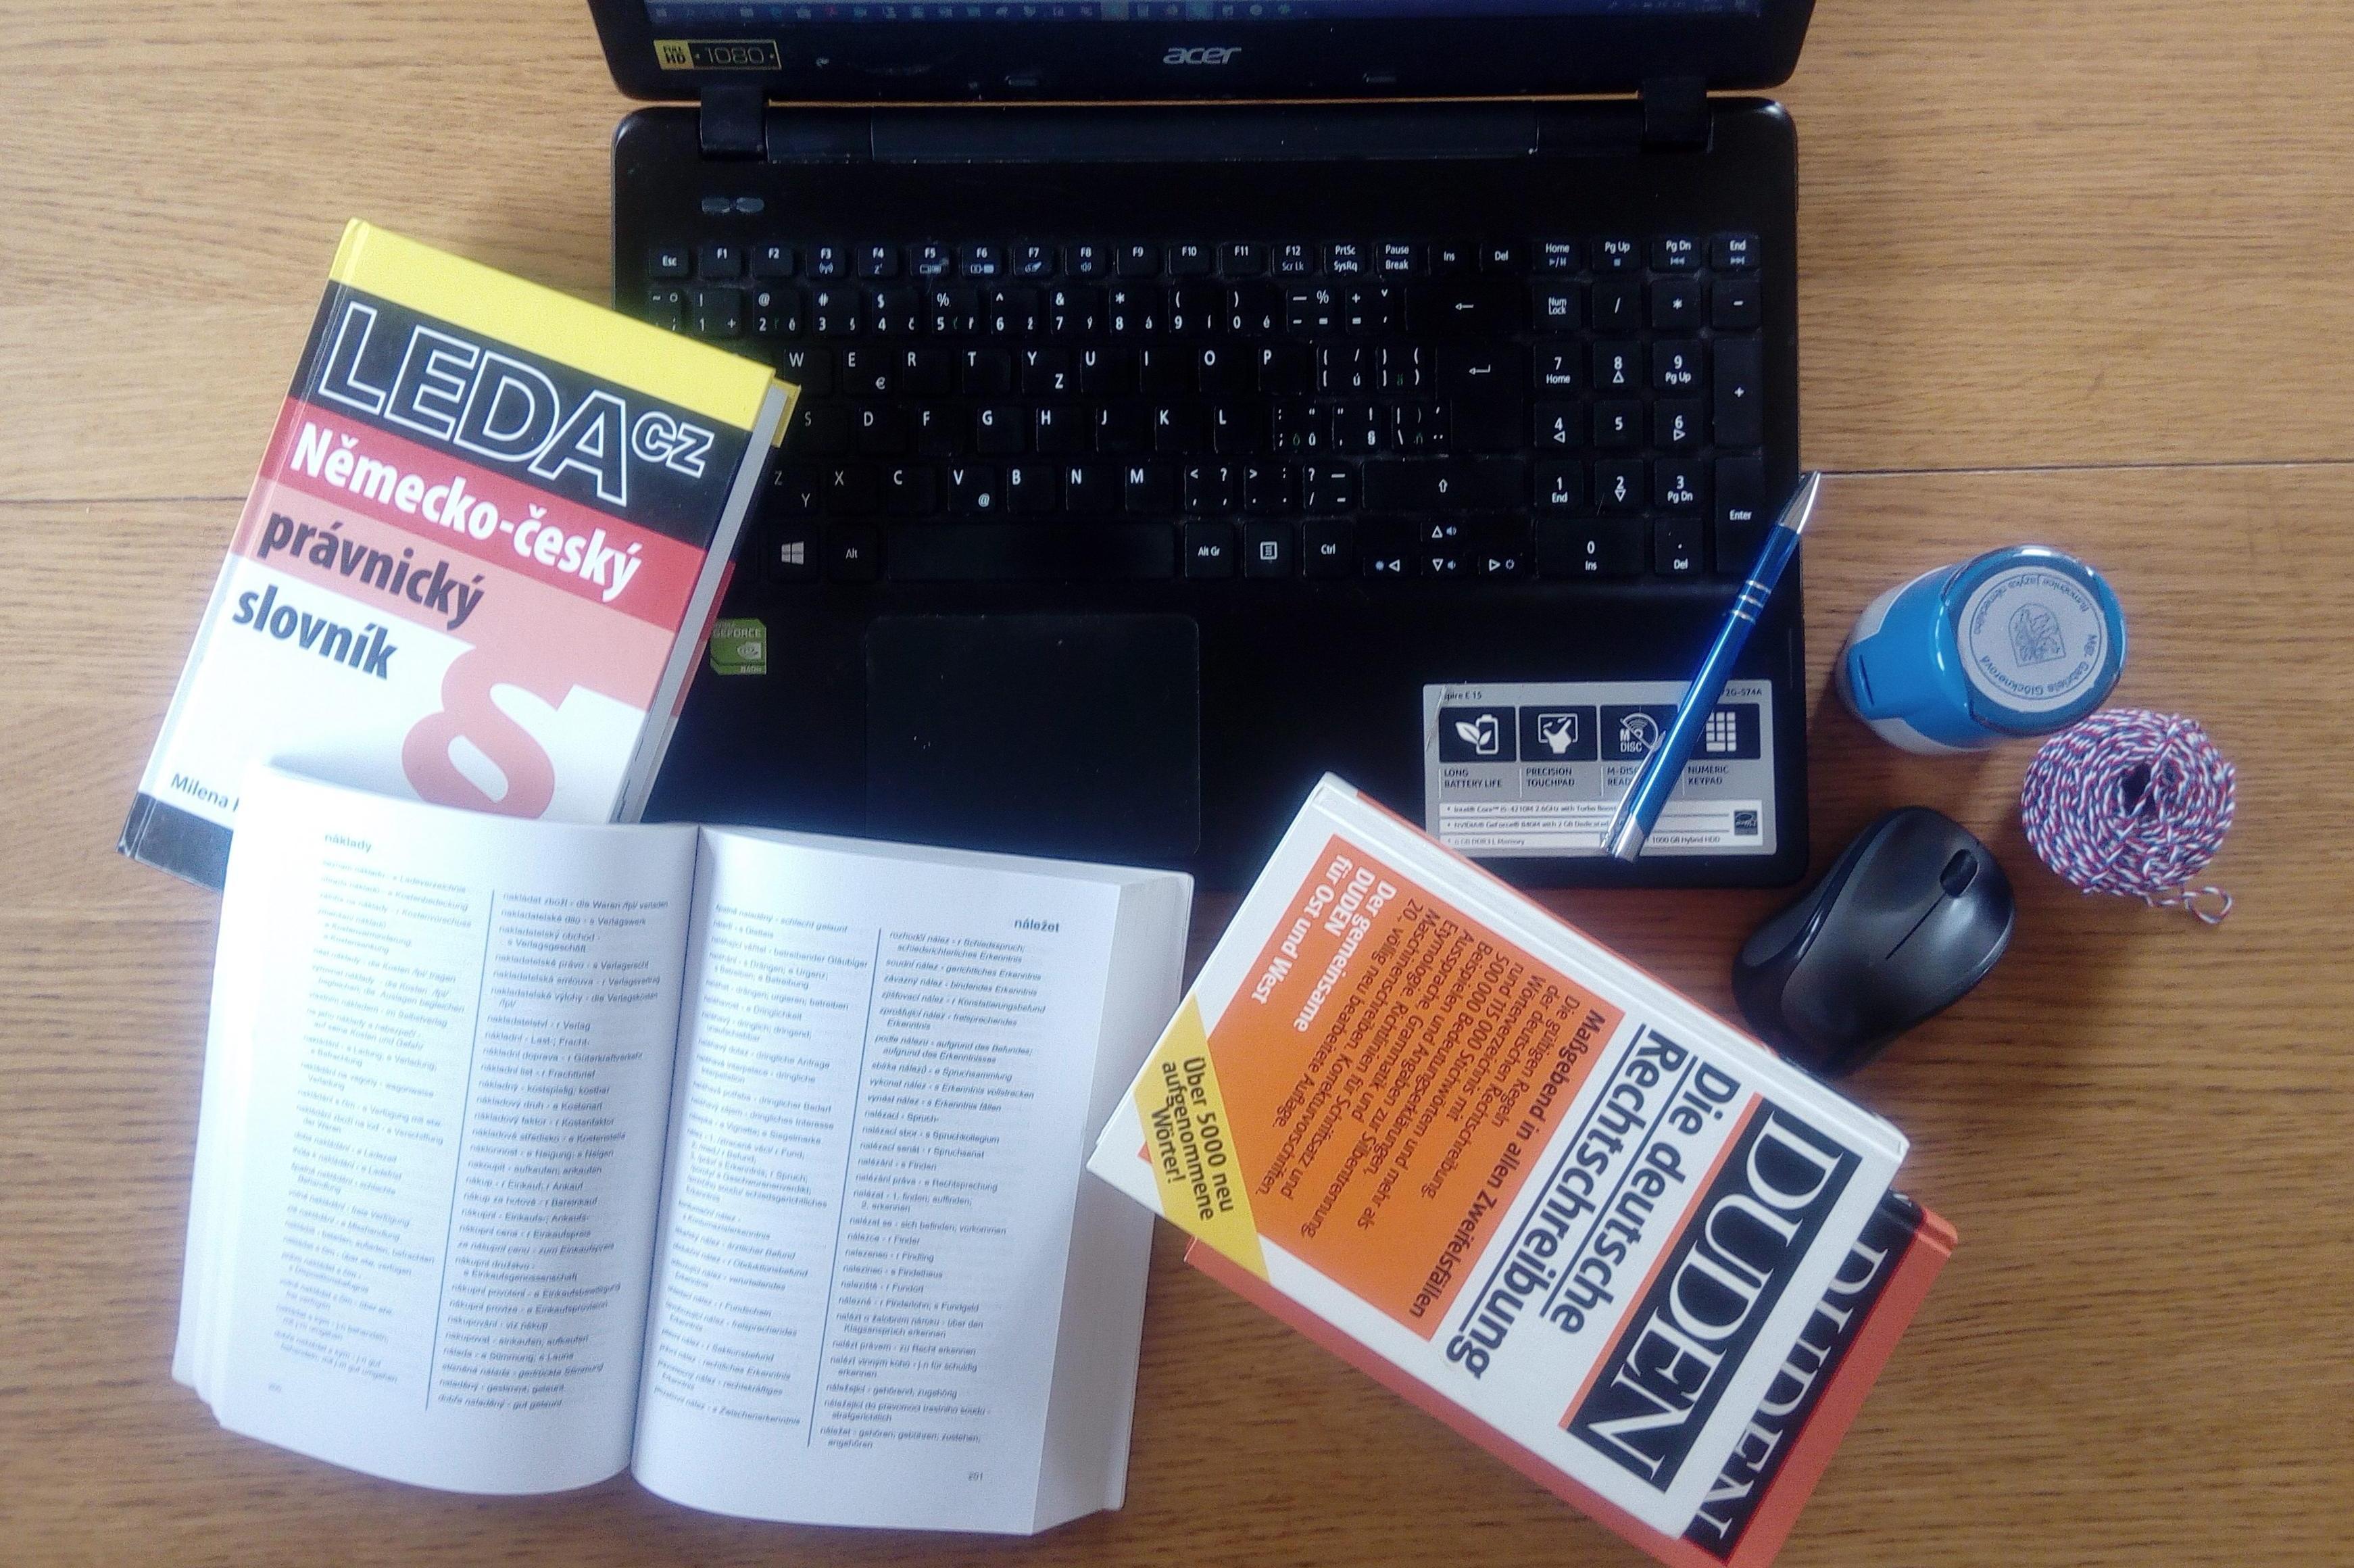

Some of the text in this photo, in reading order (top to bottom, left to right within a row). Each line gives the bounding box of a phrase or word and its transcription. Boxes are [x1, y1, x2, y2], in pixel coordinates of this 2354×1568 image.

[705, 47, 764, 64] 1080
[1162, 47, 1242, 65] acer
[1029, 247, 1039, 258] F7
[1081, 247, 1092, 257] F8
[1133, 247, 1143, 257] F9
[1182, 247, 1196, 256] F10
[1235, 246, 1248, 255] F11
[1286, 246, 1300, 255] F12
[1335, 245, 1355, 255] PrtSc
[1386, 245, 1408, 254] Pause
[1546, 243, 1569, 253] Home
[1605, 241, 1630, 253] Pg Up
[1667, 240, 1691, 252] Pg Dn
[1730, 240, 1746, 251] End
[717, 249, 727, 258] F1
[769, 248, 779, 258] F2
[821, 248, 831, 259] F3
[873, 248, 883, 258] F4
[925, 248, 935, 258] F5
[977, 248, 987, 258] F6
[1444, 251, 1454, 261] Ins
[1495, 251, 1508, 260] Del
[663, 255, 677, 266] Esc
[1334, 261, 1357, 272] SysRq
[1386, 260, 1408, 269] Break
[1549, 297, 1567, 306] Num
[1549, 306, 1565, 314] Lock
[789, 353, 804, 367] W
[849, 352, 855, 366] E
[908, 352, 916, 366] R
[968, 351, 976, 366] T
[1028, 351, 1037, 365] Y
[1086, 351, 1095, 366] U
[1204, 350, 1215, 365] O
[1264, 350, 1271, 364] P
[1554, 357, 1561, 370] 7
[1674, 356, 1682, 369] 9
[1546, 374, 1570, 383] Home
[1666, 372, 1691, 384] Pg Up
[318, 301, 715, 507] LEDA CZ
[864, 412, 873, 426] D
[923, 411, 929, 426] F
[983, 410, 992, 425] G
[1552, 492, 1567, 503] End
[1668, 491, 1692, 504] Pg Dn
[278, 422, 641, 602] Německo-český
[1730, 510, 1751, 520] Enter
[846, 548, 857, 558] Alt
[1198, 546, 1219, 556] Alt Gr
[1321, 544, 1335, 554] Ctrl
[1586, 561, 1597, 570] Ins
[1674, 559, 1688, 569] Del
[257, 512, 485, 631] právnický
[232, 585, 397, 680] slovník
[1620, 742, 1642, 752] DISC
[1444, 768, 1469, 777] LONG
[1526, 768, 1572, 776] PRECISION
[1688, 766, 1729, 774] NUMERIC
[1444, 779, 1502, 789] BATTERY LIFE
[1526, 779, 1575, 787] TOUCHPAD
[1688, 777, 1722, 785] KEYPAD
[171, 773, 228, 808] Milena
[1324, 867, 1375, 937] DUDEN
[1251, 855, 1353, 1004] für Ost und West
[1371, 928, 1404, 966] völlig
[1294, 880, 1397, 1031] Der gemeinsame
[1356, 965, 1379, 995] neu
[1440, 941, 1494, 1013] Beispielen
[1498, 962, 1524, 999] rund
[1539, 985, 1560, 1010] der
[1308, 994, 1365, 1073] bearbeitete
[1351, 930, 1475, 1123] Aussprache, Grammatik und
[1422, 1014, 1445, 1046] und
[1255, 909, 1441, 1195] Maschinenschreiben. Korrekturvorschriften.
[1446, 975, 1546, 1123] Wörterverzeichnis mit
[1494, 1010, 1544, 1083] deutschen
[1280, 920, 1458, 1200] Etymologie. Richtlinien für Schriftsatz und
[1492, 995, 1580, 1127] Die gültigen Regeln
[1383, 1042, 1429, 1106] Angaben
[1272, 1073, 1315, 1127] Auflage.
[1363, 1012, 1475, 1175] Bedeutungserklärungen,
[1413, 1049, 1475, 1137] Stichwörtern
[1369, 1106, 1388, 1133] zur
[1162, 1062, 1214, 1221] aufgenommene
[1183, 1057, 1234, 1212] Über 5000 neu
[1151, 1106, 1186, 1183] Wörter!
[1394, 1138, 1418, 1171] und
[1409, 1009, 1605, 1318] Maßgebend in allen Zweifelsfällen
[1371, 1168, 1399, 1208] mehr
[1446, 1029, 1689, 1379] Rechtschreibung
[1550, 1062, 1741, 1334] Die deutsche
[1357, 1207, 1375, 1230] als
[1575, 1110, 1843, 1479] DUDEN
